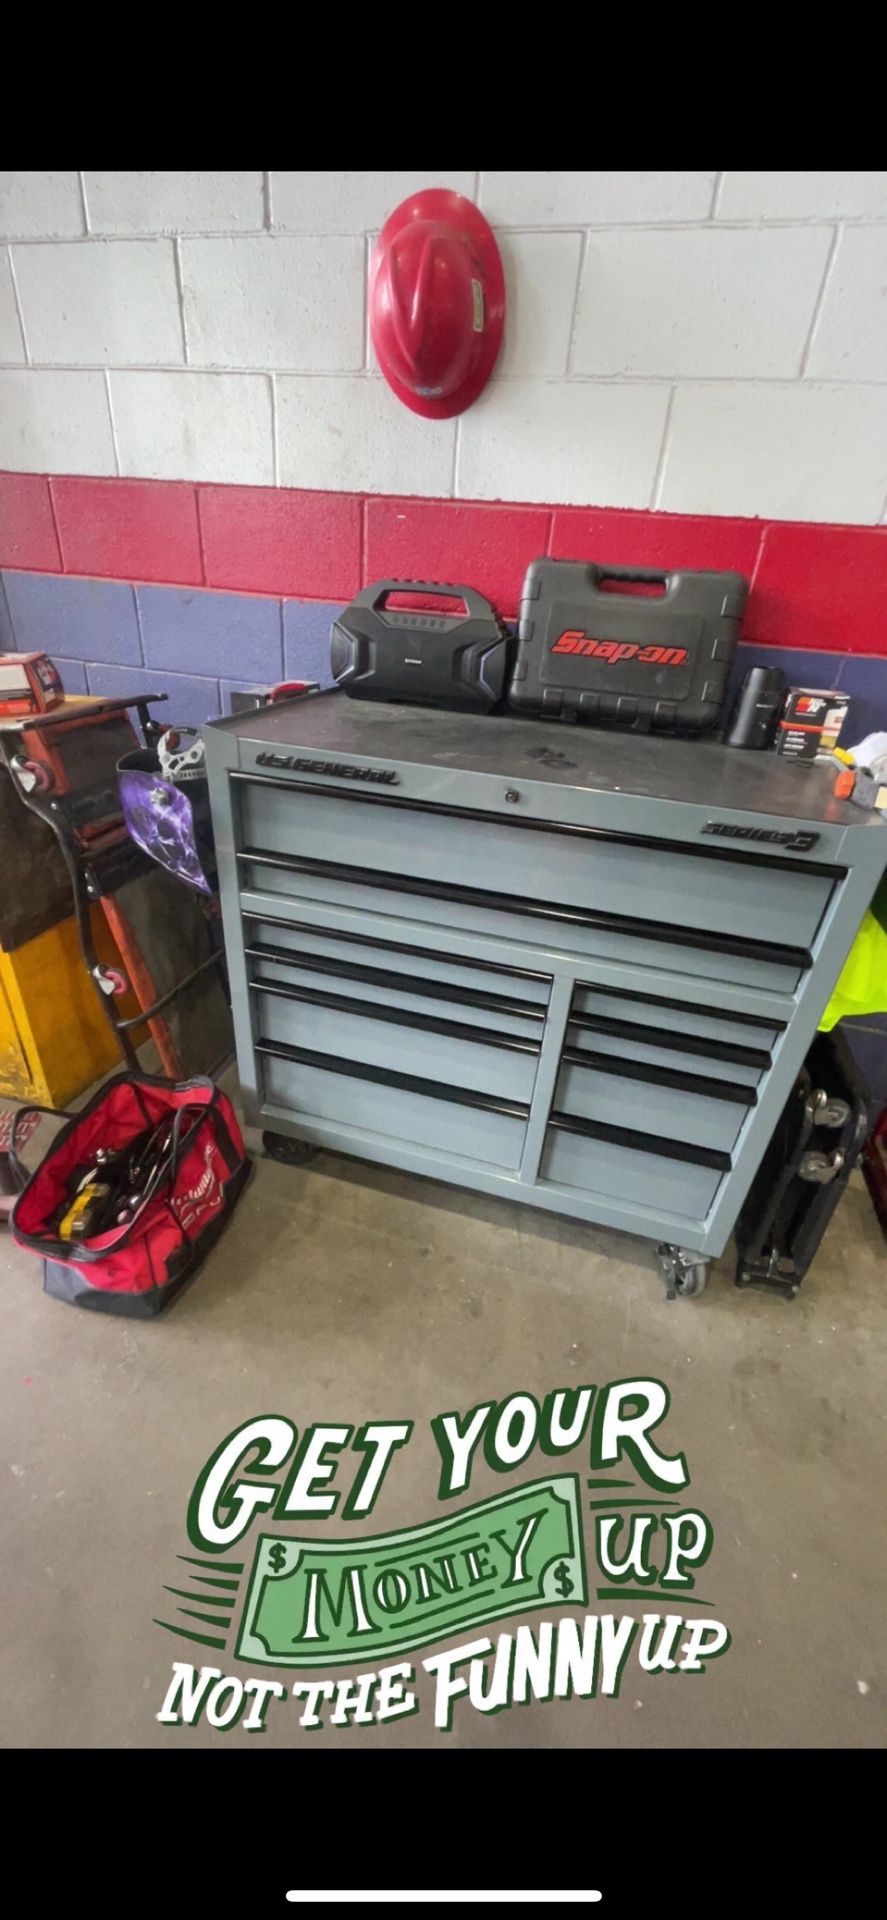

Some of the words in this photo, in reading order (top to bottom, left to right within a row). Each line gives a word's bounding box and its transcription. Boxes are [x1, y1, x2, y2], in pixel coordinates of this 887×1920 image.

[550, 629, 688, 666] Snap-on
[293, 758, 400, 786] GENERAL
[701, 822, 795, 844] SERIES
